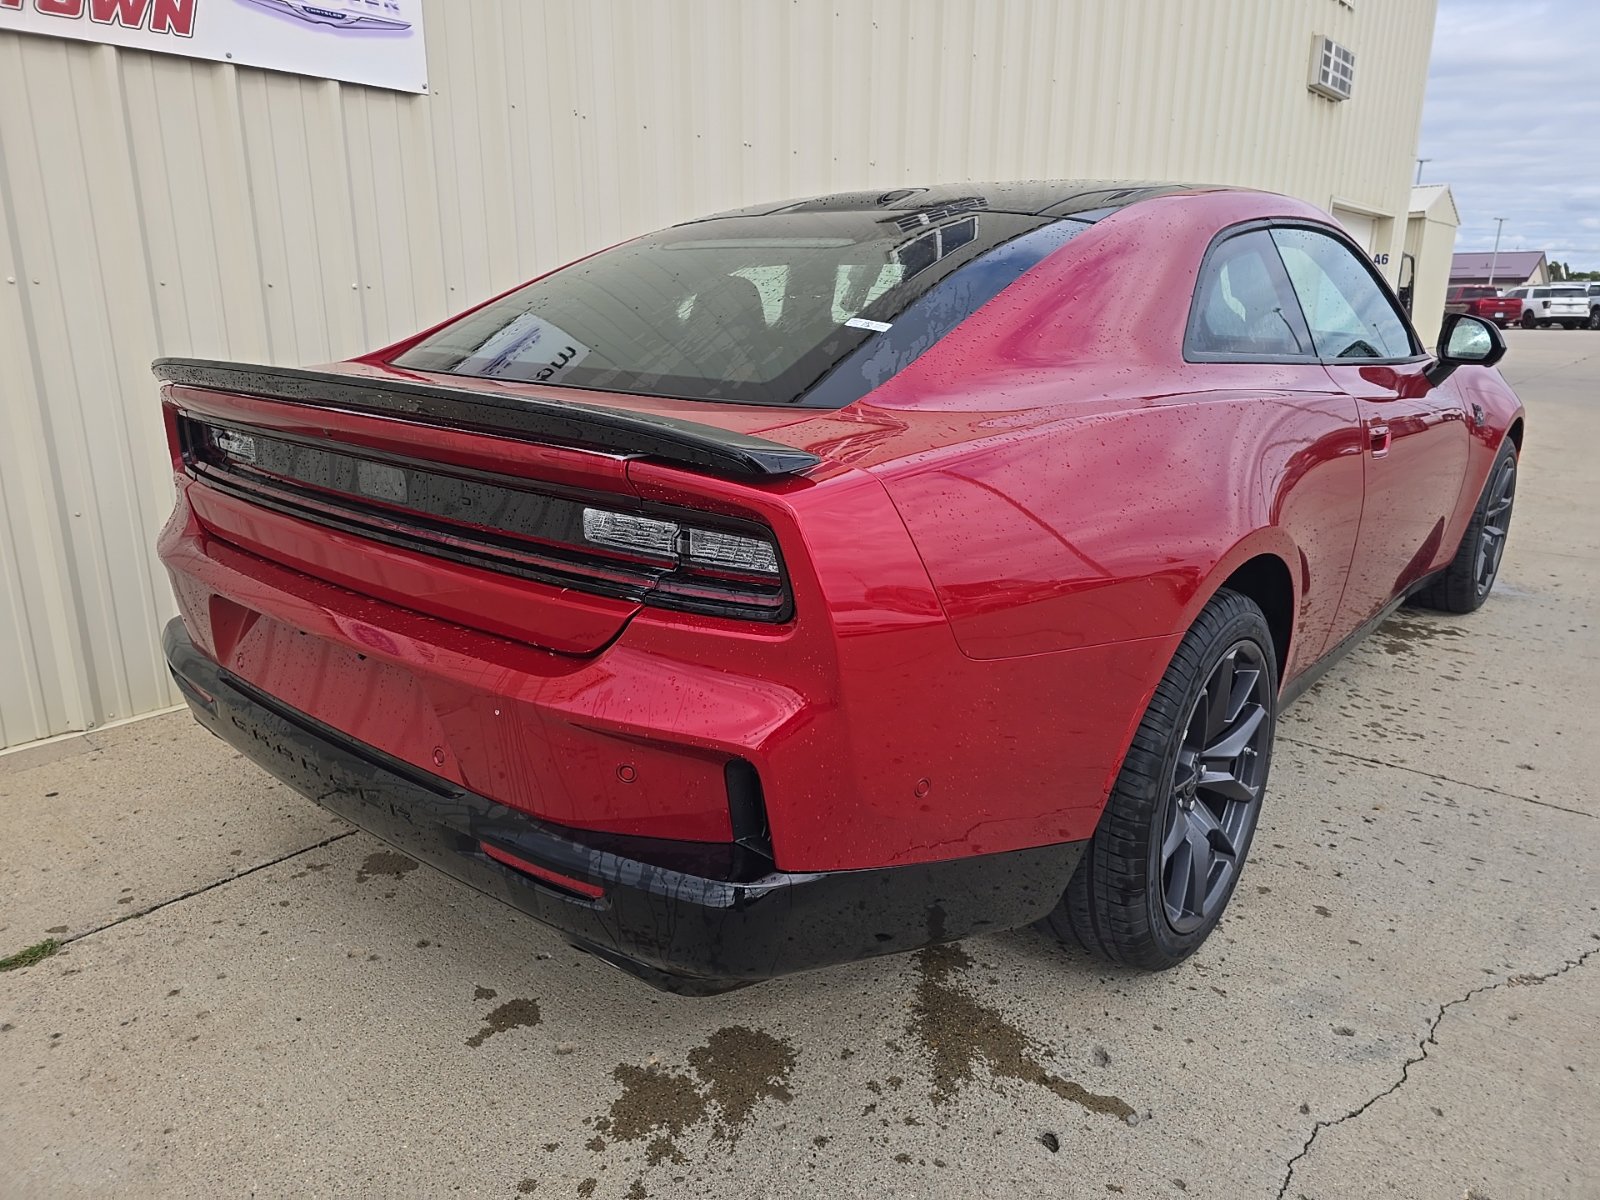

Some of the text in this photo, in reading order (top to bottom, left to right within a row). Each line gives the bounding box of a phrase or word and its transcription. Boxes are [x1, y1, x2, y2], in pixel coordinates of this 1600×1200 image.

[0, 0, 196, 37] WN
[305, 7, 344, 19] CHRYSLER
[1373, 253, 1389, 265] A6
